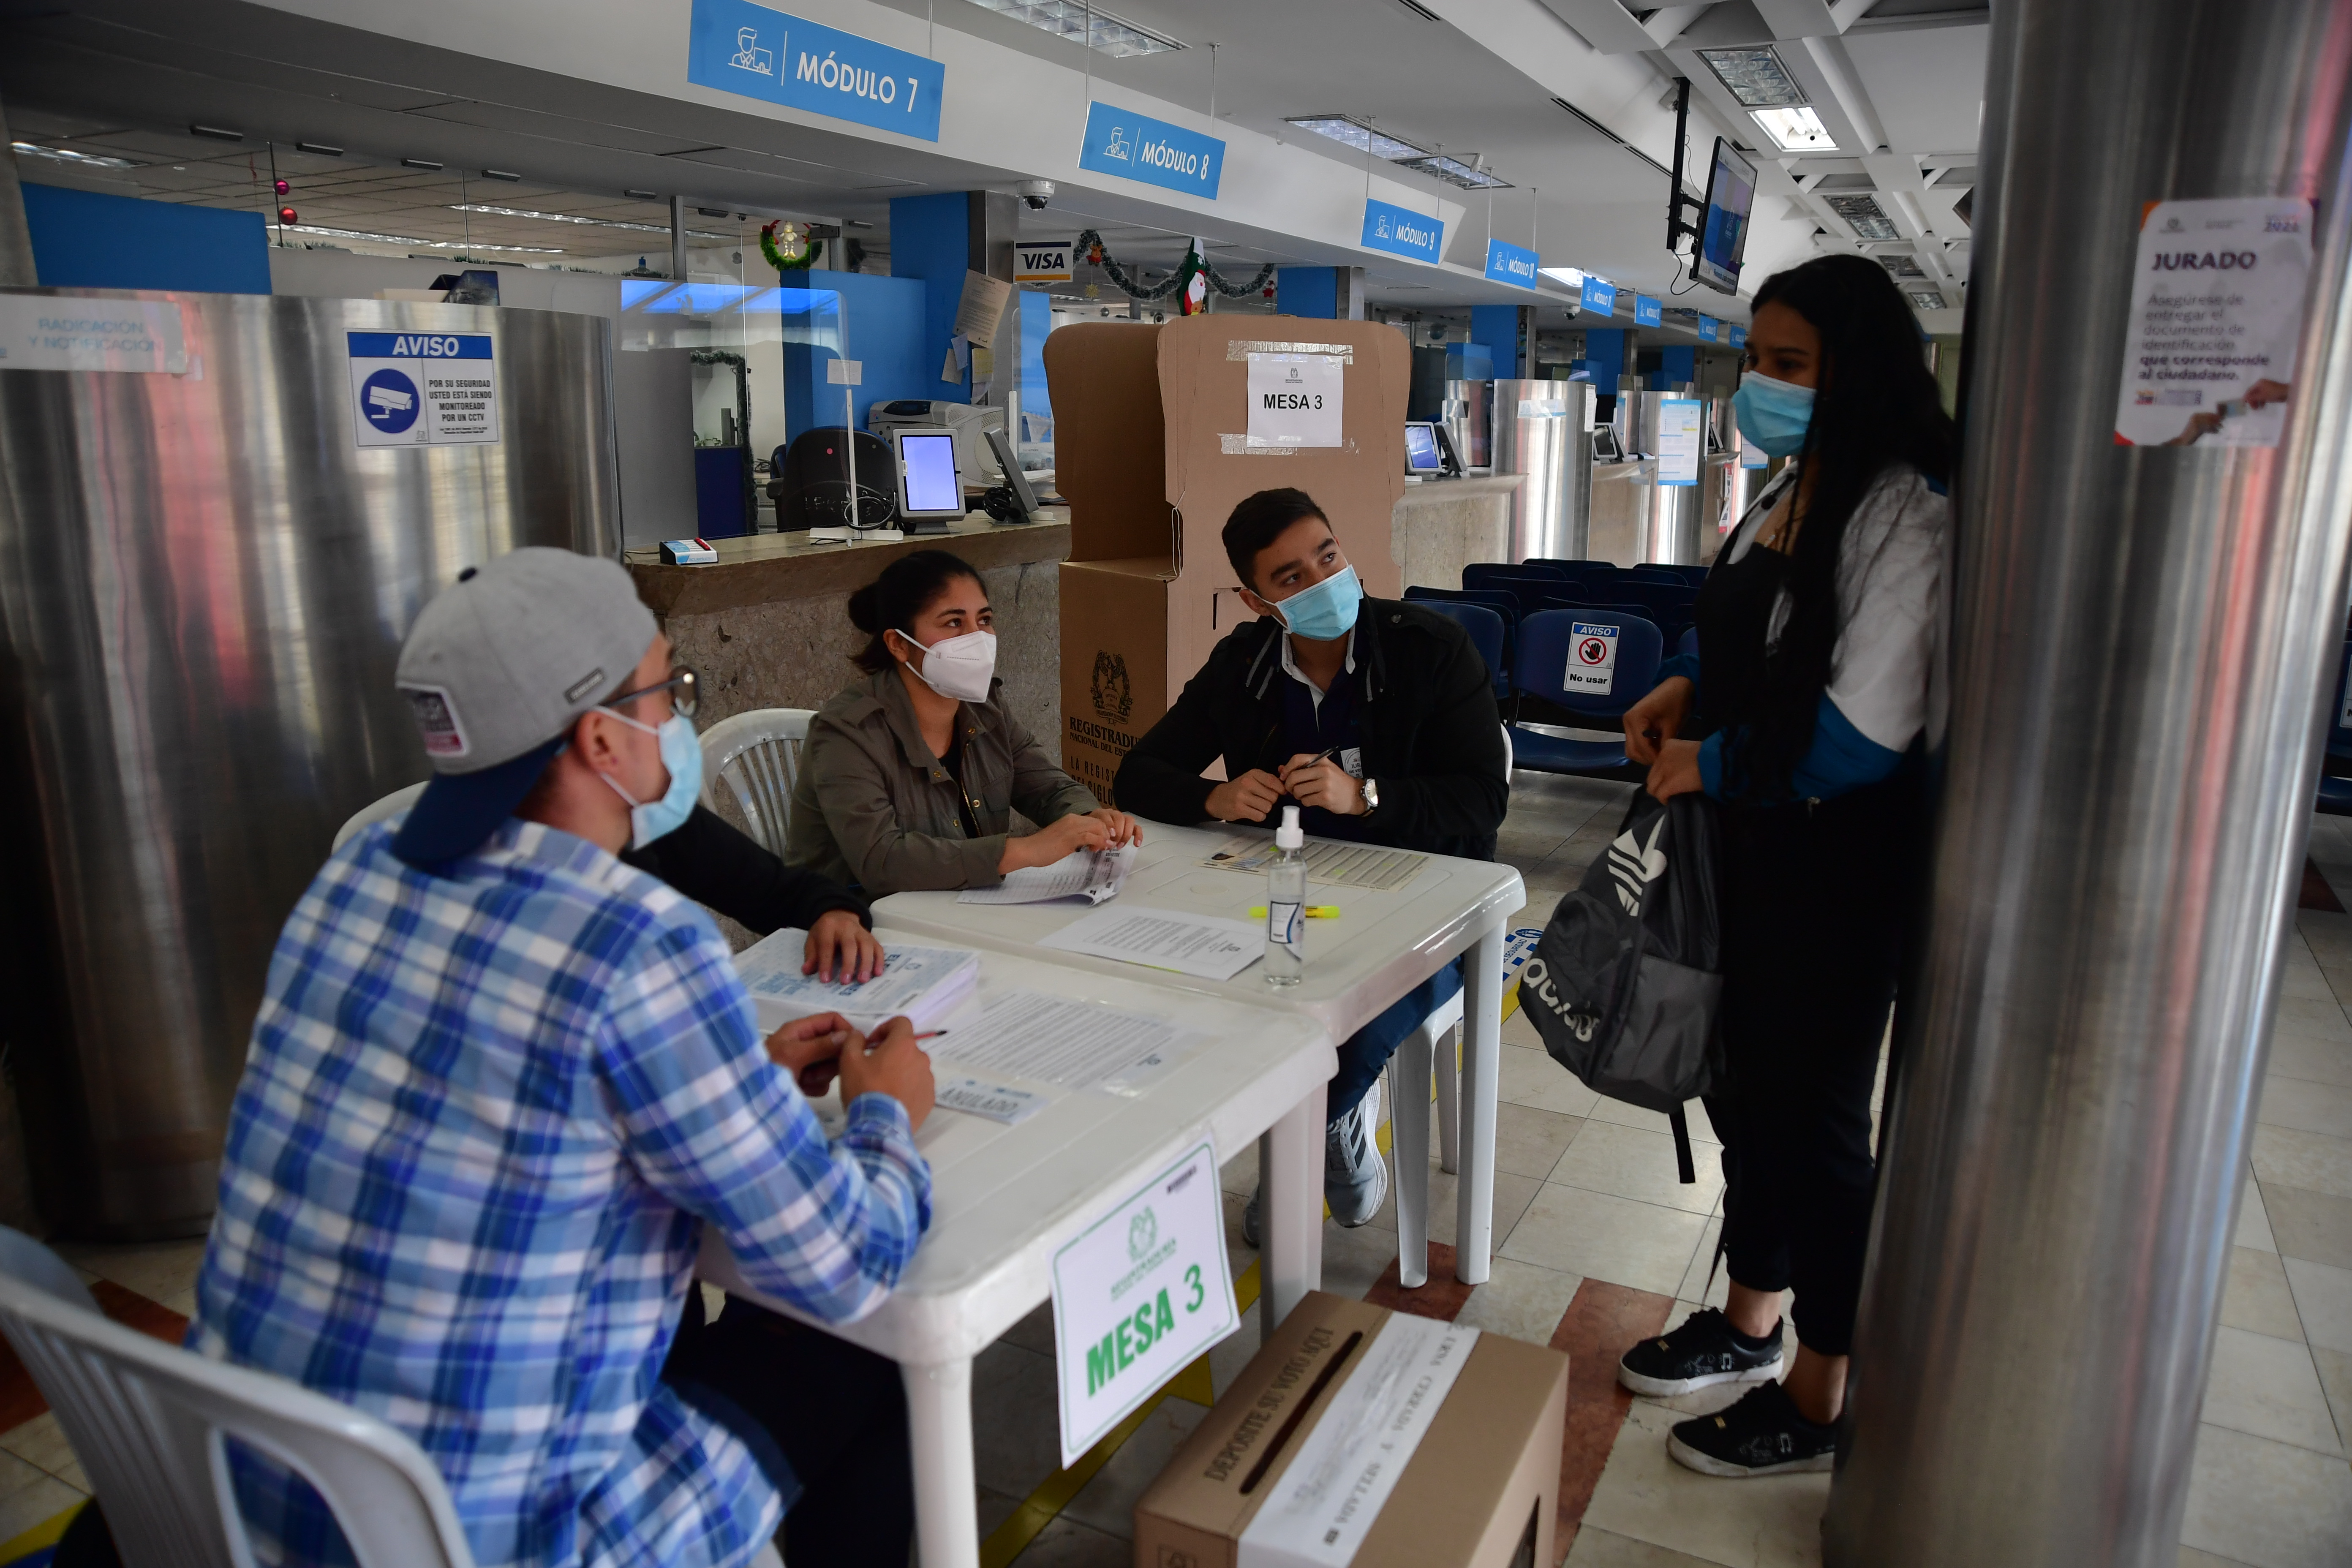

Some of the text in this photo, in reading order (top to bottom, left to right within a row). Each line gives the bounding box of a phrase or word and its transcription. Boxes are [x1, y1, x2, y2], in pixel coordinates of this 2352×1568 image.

[797, 51, 918, 113] MÓDULO 7
[1141, 139, 1209, 180] MÓDULO 8
[1396, 222, 1435, 250] MÓDULO 9
[1021, 253, 1065, 269] VISA
[1508, 257, 1529, 276] MÓDULO
[2152, 251, 2257, 270] JURADO
[2148, 293, 2244, 308] Asegúrese de
[2146, 309, 2223, 322] entregar el
[2144, 325, 2245, 336] documento de
[392, 336, 459, 357] AVISO
[2142, 339, 2235, 351] identificación
[2140, 355, 2270, 367] que corresponde
[2138, 369, 2152, 380] al
[453, 389, 468, 399] ESTÁ
[1264, 394, 1323, 410] MESA 3
[1580, 626, 1612, 636] AVISO
[1570, 673, 1583, 682] No
[1070, 716, 1141, 749] REGISTRADU
[1070, 732, 1127, 757] NACIONAL DEL EST
[1071, 756, 1079, 771] LA
[1085, 761, 1114, 782] REGIST
[1088, 781, 1113, 806] SIGLO
[1504, 939, 1527, 958] SEGURIDAD
[1086, 1287, 1176, 1397] MESA
[1183, 1263, 1205, 1314] 3
[1430, 1336, 1456, 1367] URNA
[1270, 1356, 1311, 1389] VOTO
[1257, 1390, 1285, 1411] SU
[1392, 1375, 1433, 1432] CERRADA
[1204, 1411, 1272, 1482] DEPOSITE
[1380, 1442, 1393, 1451] Y
[1334, 1462, 1381, 1524] SELLADA
